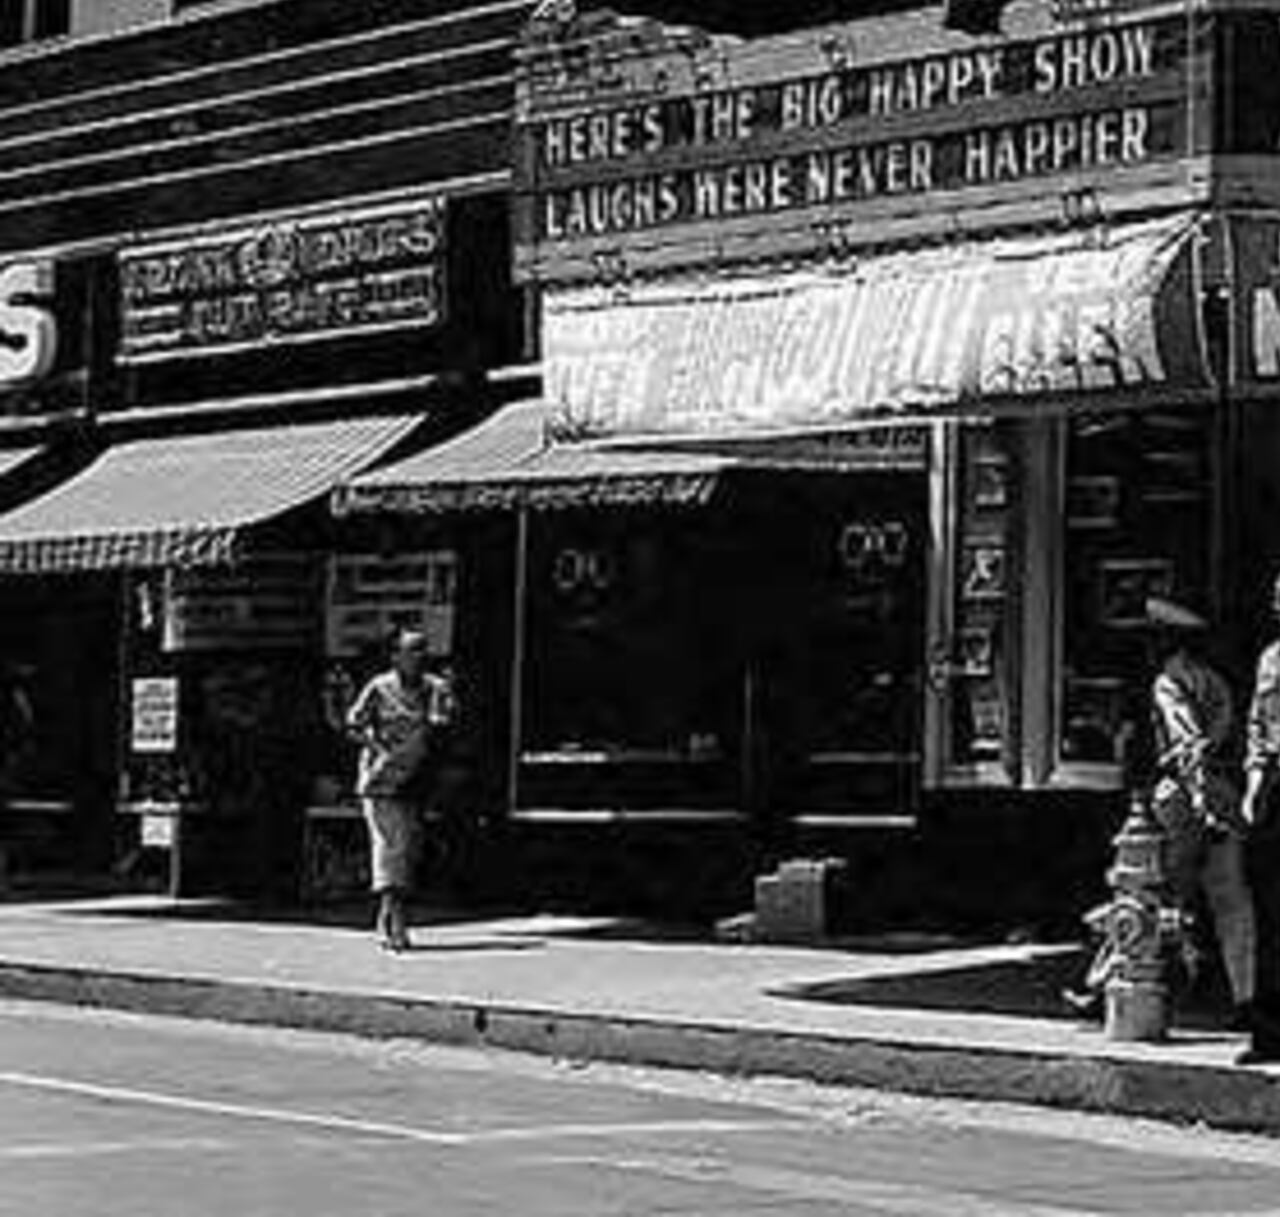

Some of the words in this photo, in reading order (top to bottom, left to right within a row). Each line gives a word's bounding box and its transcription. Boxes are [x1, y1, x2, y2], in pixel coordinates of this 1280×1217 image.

[546, 104, 664, 166] HERE'S
[692, 87, 754, 147] THE
[780, 74, 842, 132] BIG
[869, 43, 1004, 116] HAPPY
[1034, 26, 1156, 94] SHOW
[546, 172, 679, 236] LAUGHS
[693, 158, 790, 219] WERE
[807, 138, 933, 204] NEVER
[964, 106, 1150, 184] HAPPIER
